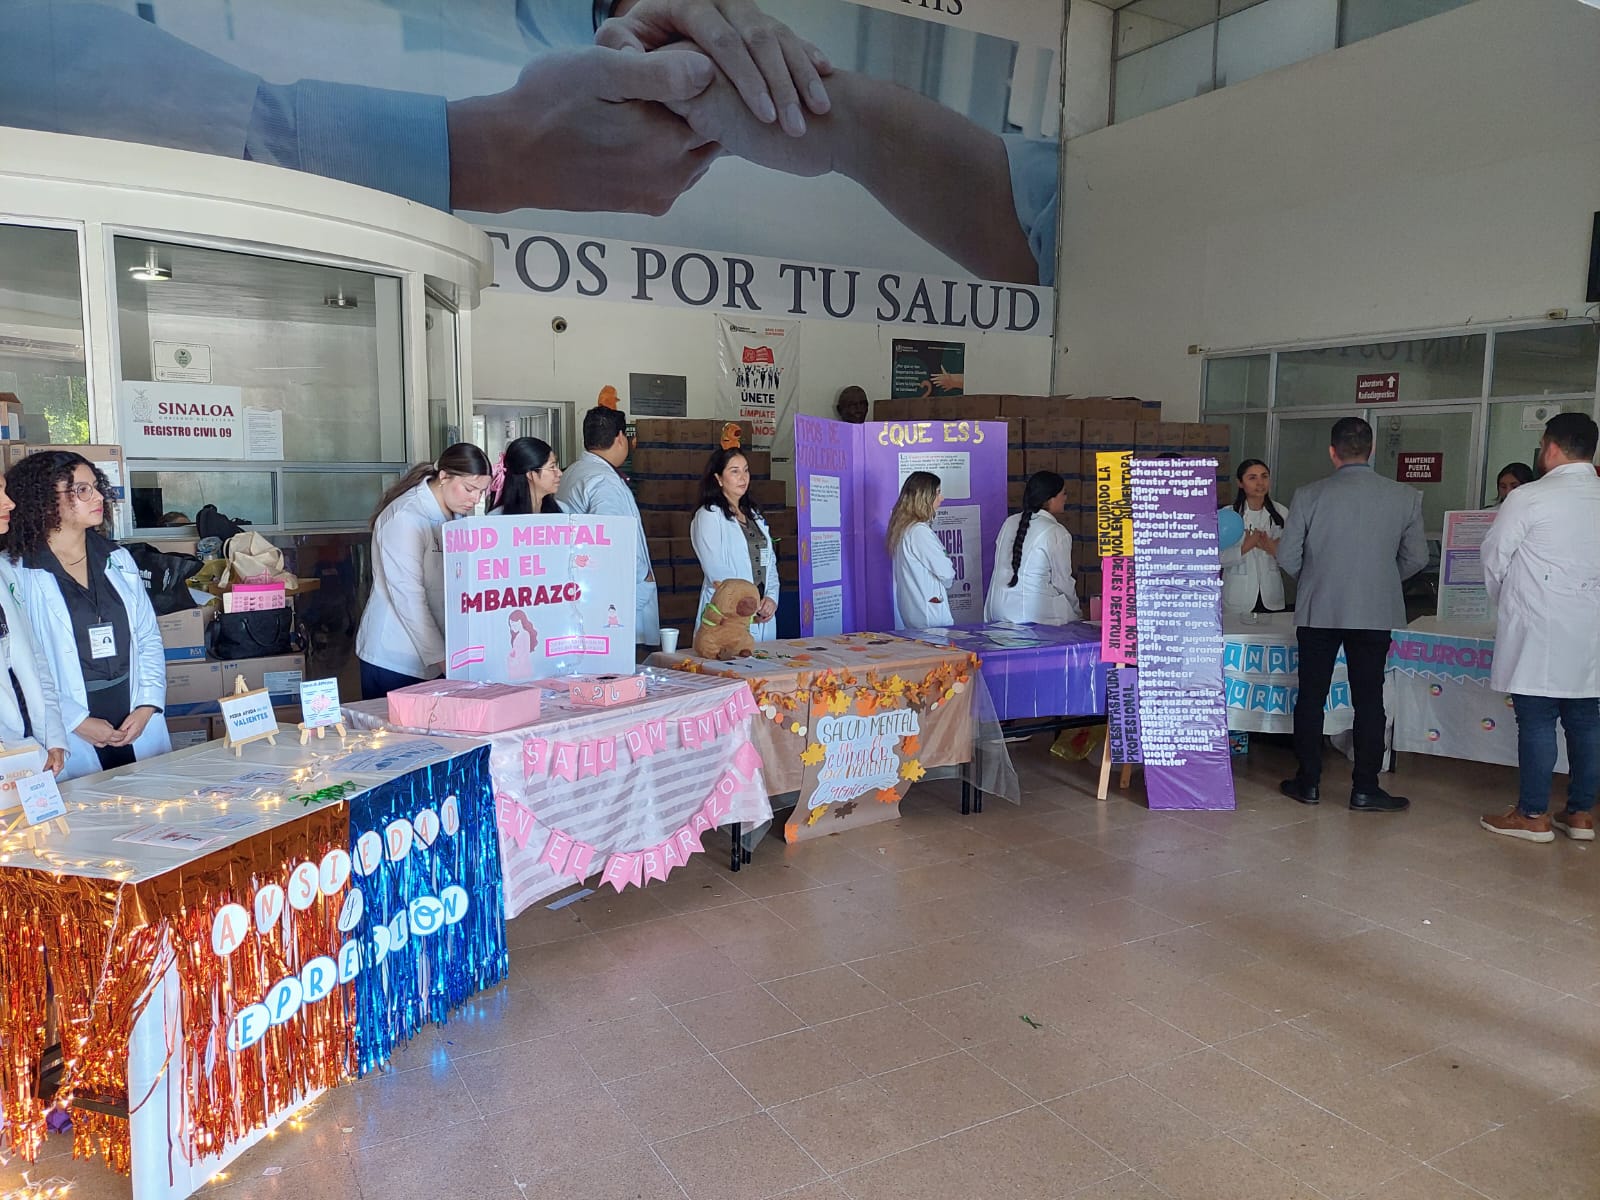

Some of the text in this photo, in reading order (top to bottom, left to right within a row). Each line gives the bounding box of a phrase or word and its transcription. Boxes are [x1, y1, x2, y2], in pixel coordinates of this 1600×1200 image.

[631, 246, 762, 311] POR
[780, 263, 861, 318] TU
[876, 273, 1040, 332] SALUD
[1359, 379, 1384, 388] Laboratorio
[741, 389, 775, 404] ÚNETE
[158, 402, 234, 417] SINALOA
[144, 426, 232, 438] REGISTRO CIVIL 09
[752, 426, 776, 436] NOS
[1129, 458, 1219, 467] bromas hirientes
[1130, 468, 1194, 478] chantajear
[1130, 476, 1213, 488] mentir engañar
[1131, 486, 1208, 498] ignorar ley del
[1131, 493, 1159, 501] hielo
[1098, 466, 1111, 555] TEN CUIDADO LA
[1132, 502, 1160, 510] celar
[1111, 500, 1124, 557] VIOLENCIA
[1133, 520, 1198, 530] descalificar
[445, 524, 611, 553] SALUD MENTAL
[1133, 530, 1216, 539] ridiculizar ofen
[1134, 537, 1152, 545] der
[1134, 546, 1179, 555] humillar
[1196, 546, 1219, 557] publ
[477, 555, 546, 581] EN EL
[1135, 577, 1186, 585] controlar
[461, 582, 582, 614] EMBARAZO
[1136, 592, 1180, 600] destruir
[1109, 558, 1124, 650] DEJES DESTRUIR
[1153, 601, 1215, 609] personales
[1137, 610, 1191, 618] manosear
[1125, 625, 1137, 640] NO
[1137, 632, 1179, 642] golpear
[1124, 642, 1137, 659] TE
[1388, 639, 1493, 669] NEUROD
[1138, 653, 1183, 663] empujar
[1138, 669, 1194, 678] cachetear
[1138, 679, 1176, 688] patear
[233, 712, 268, 727] VALIENTES
[1123, 683, 1139, 762] PROFESIONAL
[822, 713, 916, 744] SALUD MENTAL
[1173, 735, 1209, 744] sexual
[1141, 743, 1213, 752] abuso sexual
[1143, 750, 1177, 758] violar
[1144, 758, 1187, 766] mutilar
[498, 800, 530, 835] EN
[549, 839, 585, 870] EL
[219, 807, 456, 950] ANSIEDAD
